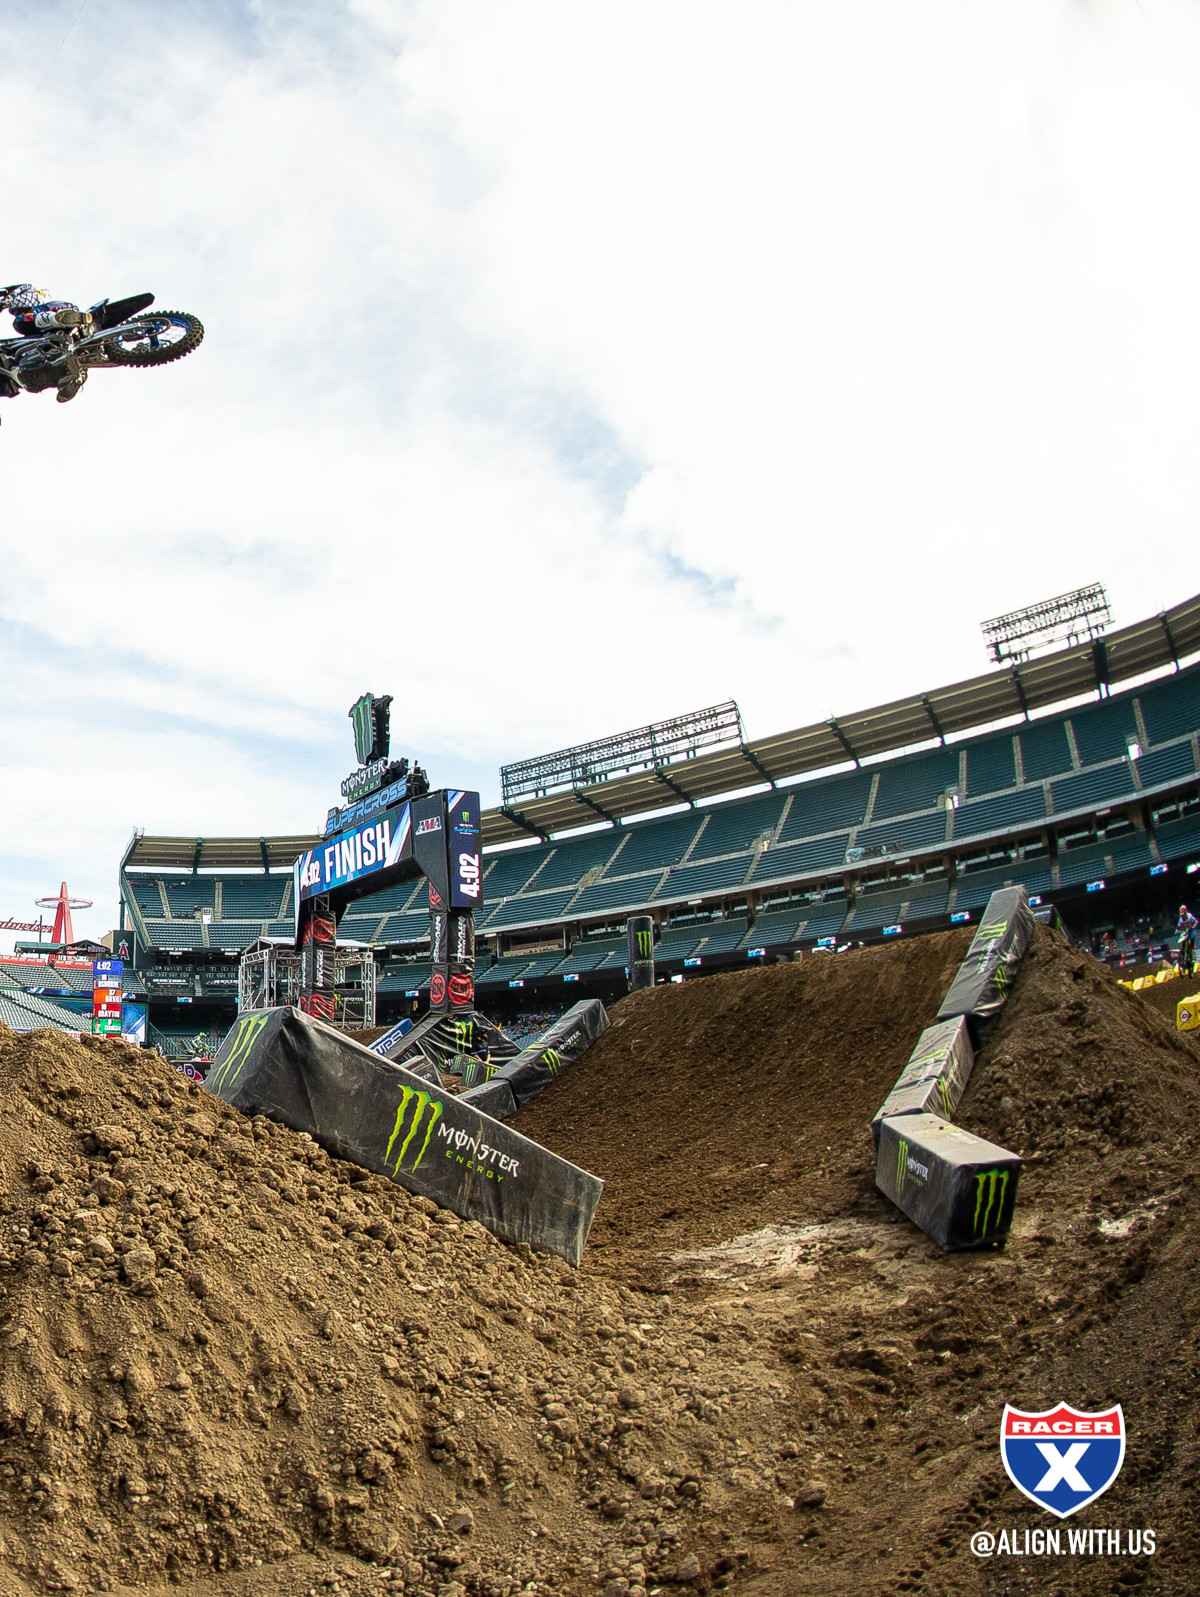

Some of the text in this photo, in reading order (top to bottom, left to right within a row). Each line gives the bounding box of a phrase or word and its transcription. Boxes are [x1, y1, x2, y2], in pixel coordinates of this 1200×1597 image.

[342, 759, 386, 794] MONSTER
[349, 780, 379, 801] ENERGY
[325, 778, 408, 835] SUPERCROSS
[418, 816, 441, 834] AMA
[324, 819, 391, 883] FINISH
[303, 860, 321, 888] 4:02
[459, 853, 481, 898] 4:02
[96, 961, 112, 971] 4:02
[437, 1122, 520, 1178] MONSTER
[445, 1150, 504, 1183] ENERGY
[907, 1156, 928, 1181] MONSTER
